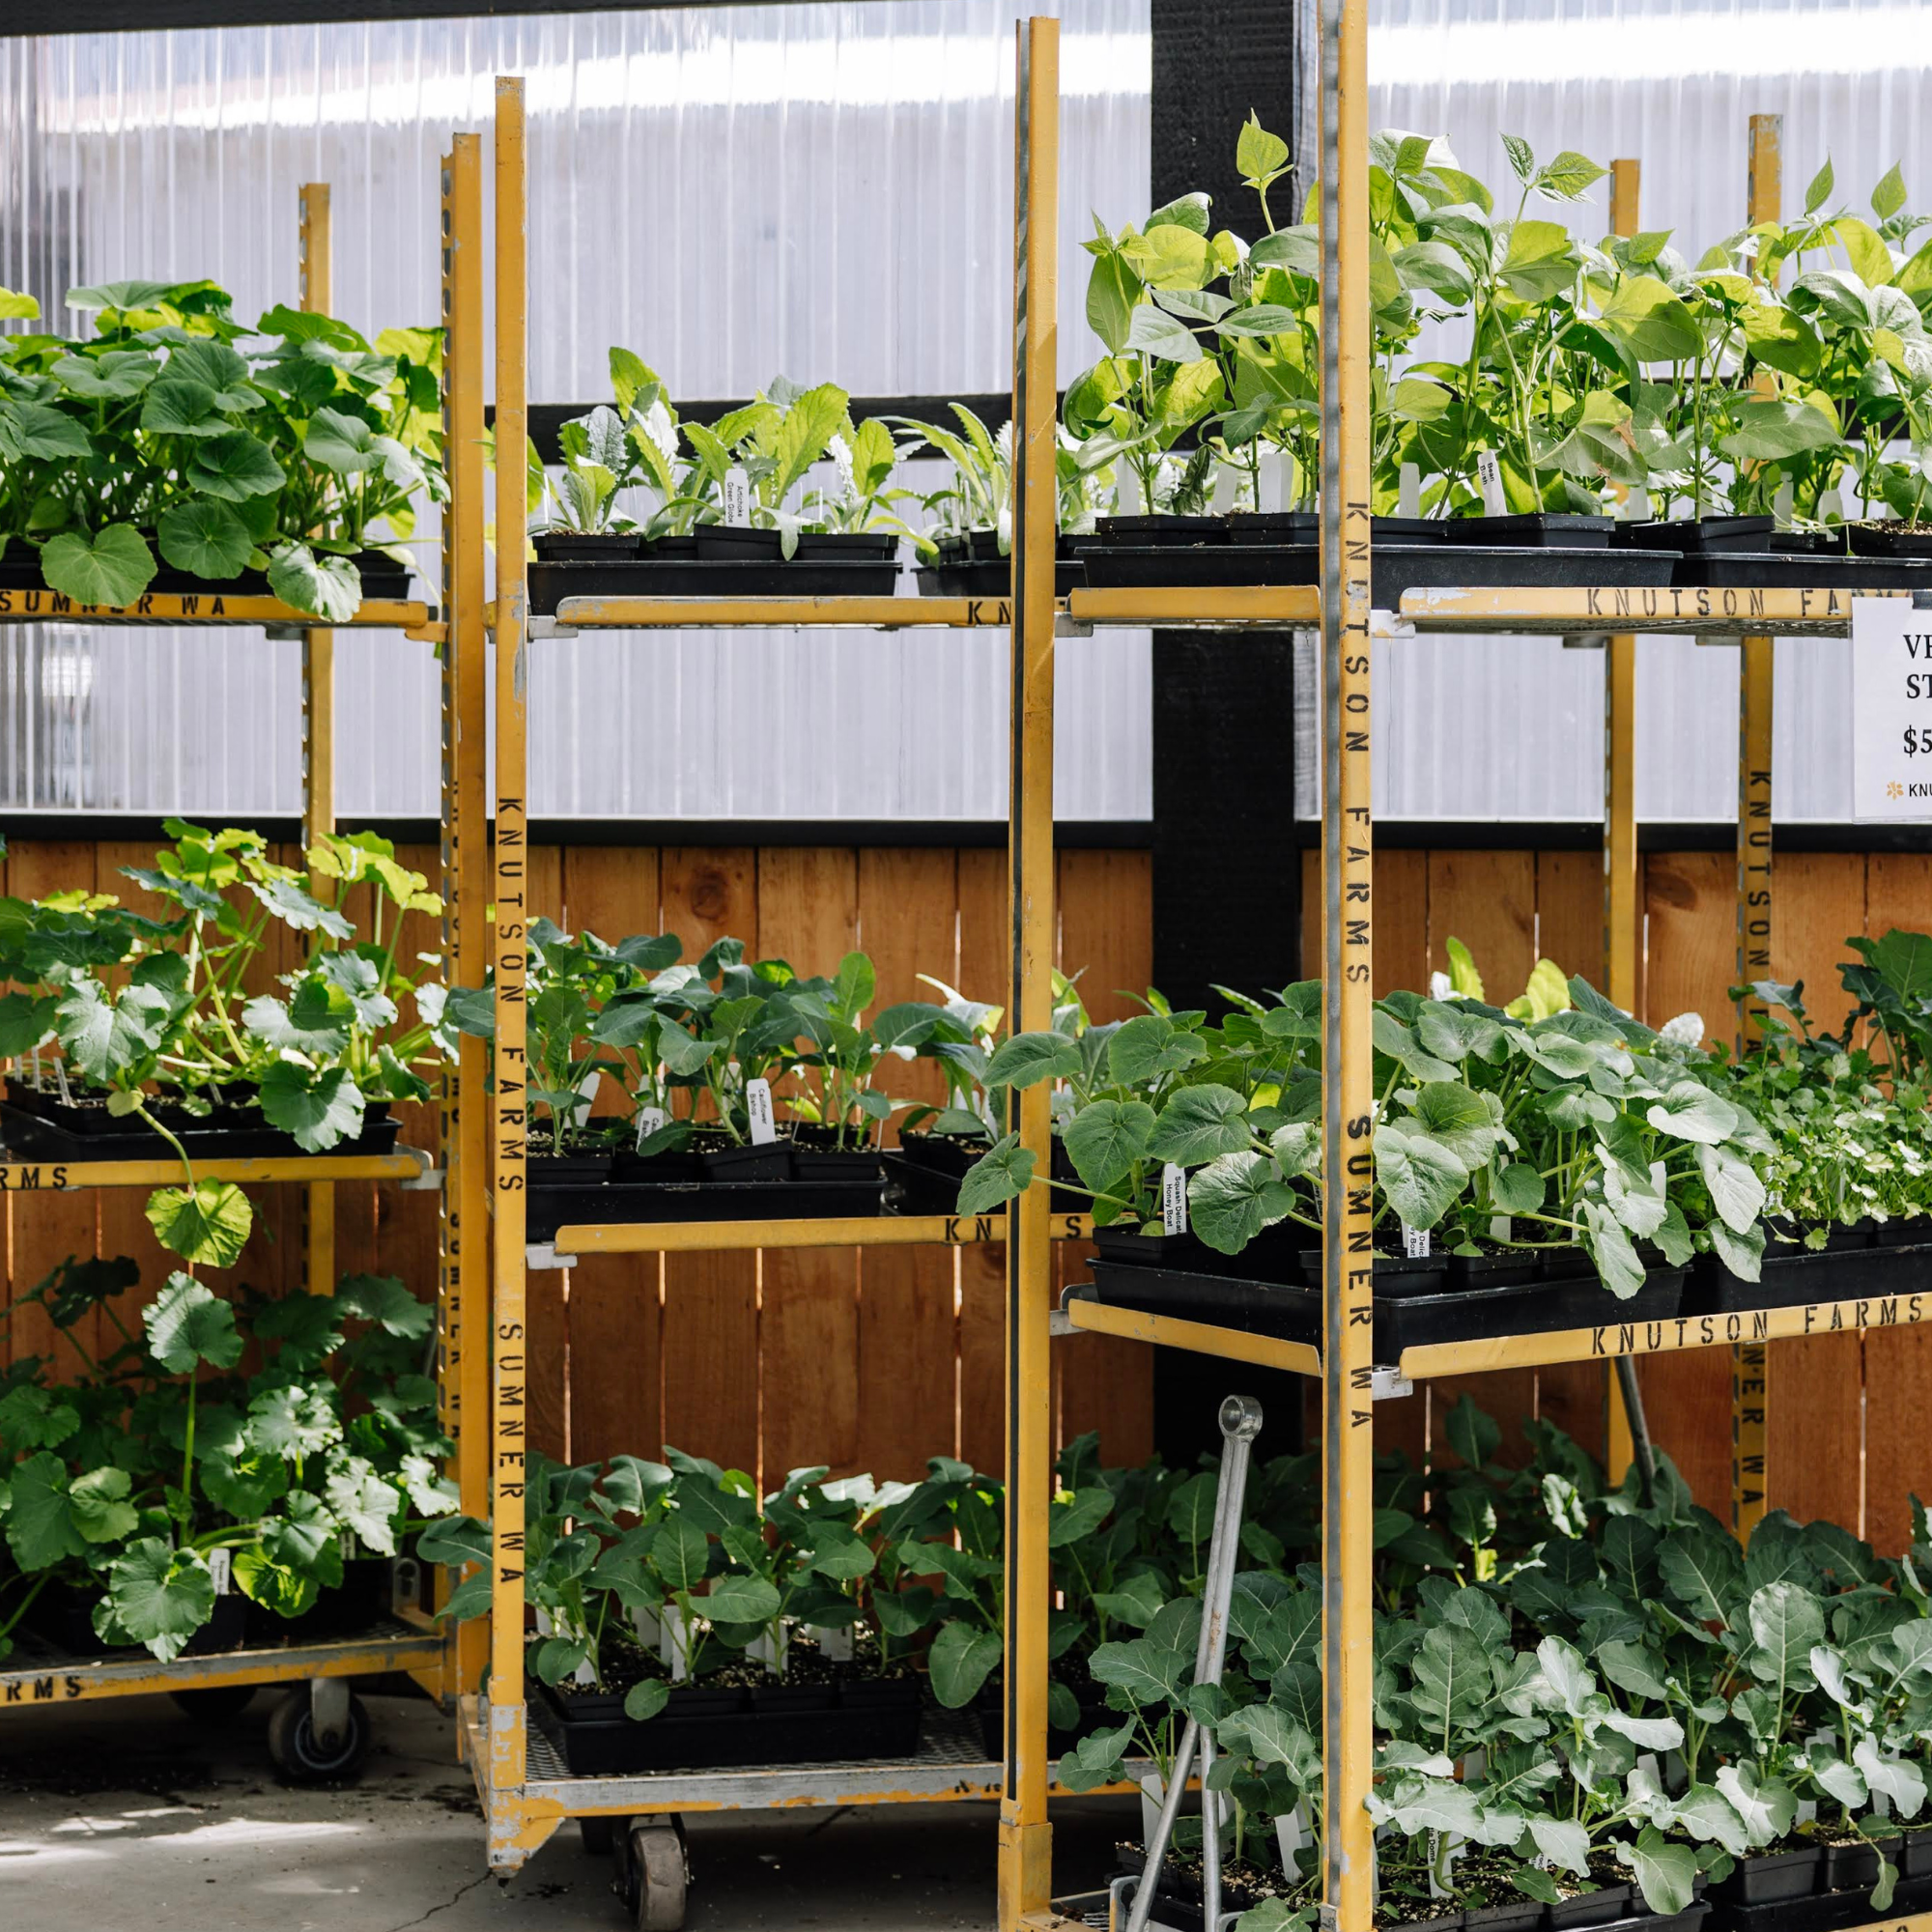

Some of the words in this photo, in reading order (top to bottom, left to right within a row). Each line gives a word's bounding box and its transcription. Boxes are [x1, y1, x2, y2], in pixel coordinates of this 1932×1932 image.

[1479, 465, 1489, 485] Bush
[182, 595, 225, 615] WA
[1586, 587, 1765, 616] KNUTSON
[498, 798, 524, 1003] KNUTSON
[1346, 807, 1370, 983] FARMS
[1747, 771, 1772, 967] KNUTSON
[498, 1047, 525, 1191] FARMS
[1347, 1115, 1373, 1327] SUMNER
[1591, 1312, 1769, 1355] KNUTSON
[1804, 1295, 1923, 1334] FARMS
[498, 1323, 524, 1499] SUMNER
[1350, 1366, 1373, 1429] WA
[1742, 1455, 1765, 1505] WA
[499, 1531, 525, 1583] WA
